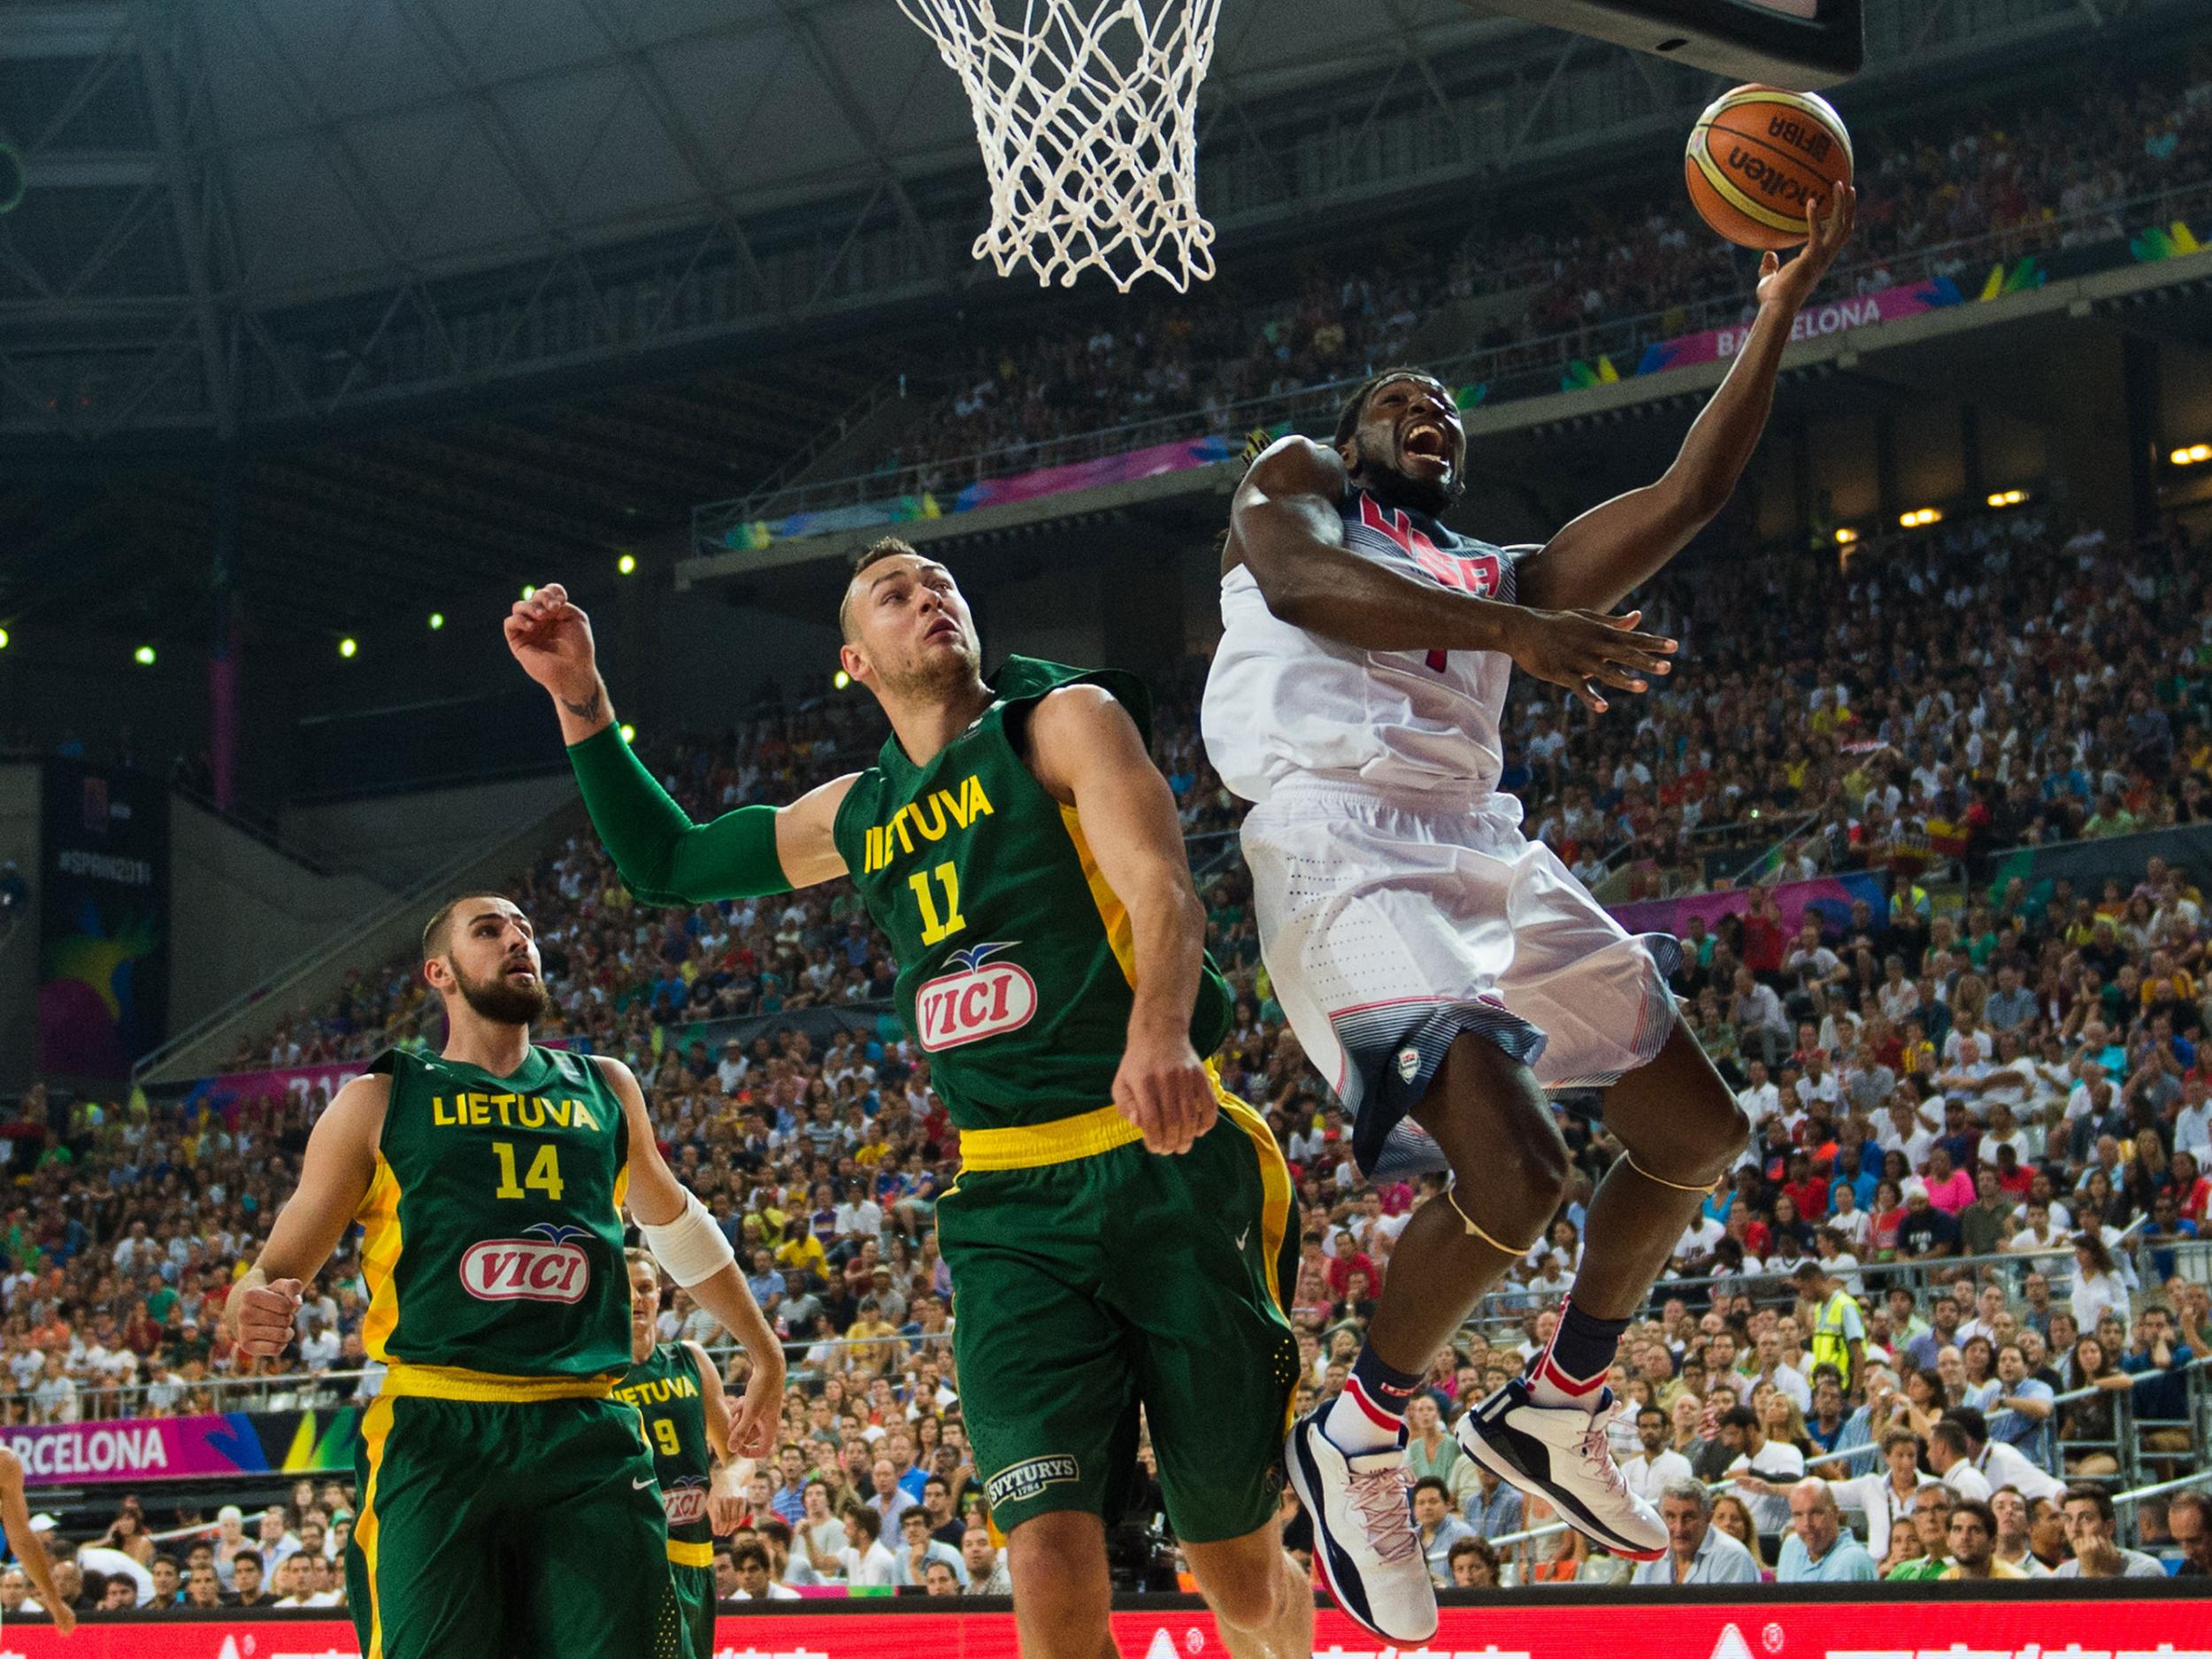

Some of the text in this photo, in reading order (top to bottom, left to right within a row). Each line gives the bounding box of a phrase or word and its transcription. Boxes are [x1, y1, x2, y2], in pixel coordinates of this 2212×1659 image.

[1767, 116, 1814, 155] FIBA
[1717, 299, 1880, 356] BAELONA
[908, 860, 967, 947] 11
[924, 974, 1013, 1040] VICI
[432, 1092, 600, 1132] LIETUVA
[492, 1141, 565, 1201] 14
[481, 1251, 581, 1291] VICI
[612, 1376, 699, 1407] IETUVA
[0, 1426, 169, 1476] RCELONA
[652, 1418, 681, 1456] 9
